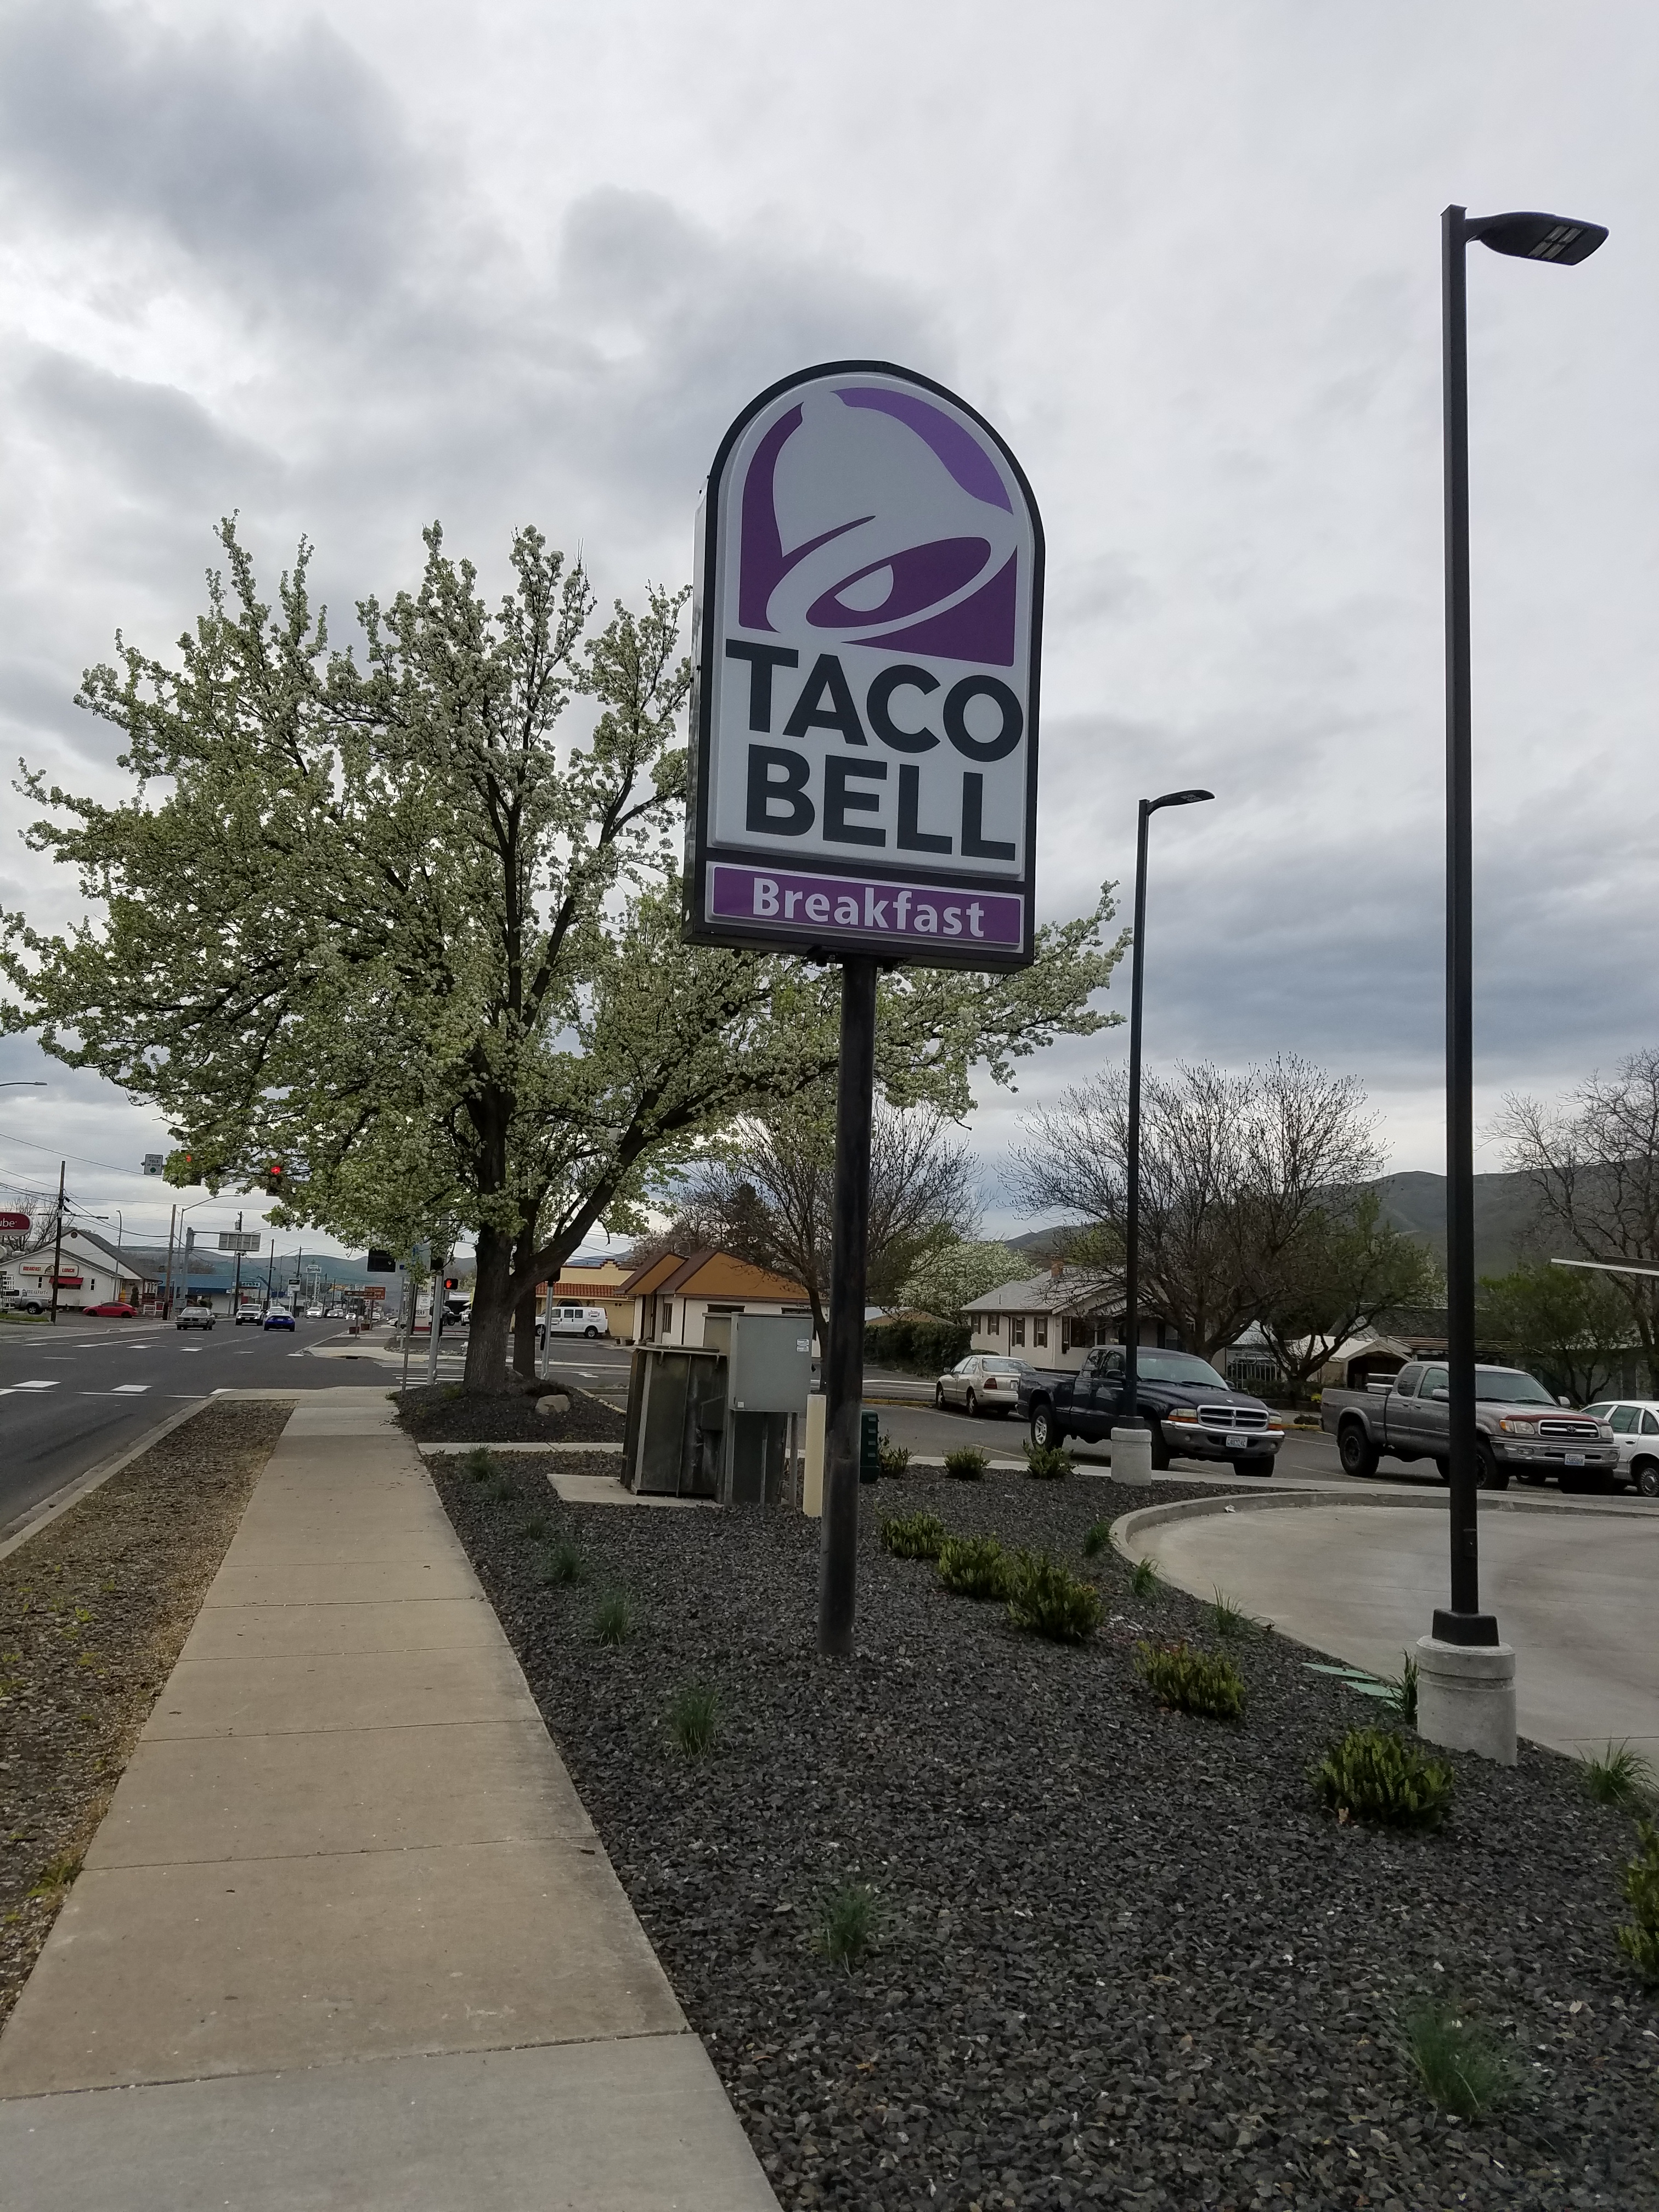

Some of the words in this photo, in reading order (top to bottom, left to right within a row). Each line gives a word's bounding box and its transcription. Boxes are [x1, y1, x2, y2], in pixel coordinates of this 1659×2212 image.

[725, 639, 1023, 763] TACO
[746, 743, 1016, 861] BELL
[752, 877, 985, 938] Breakfast
